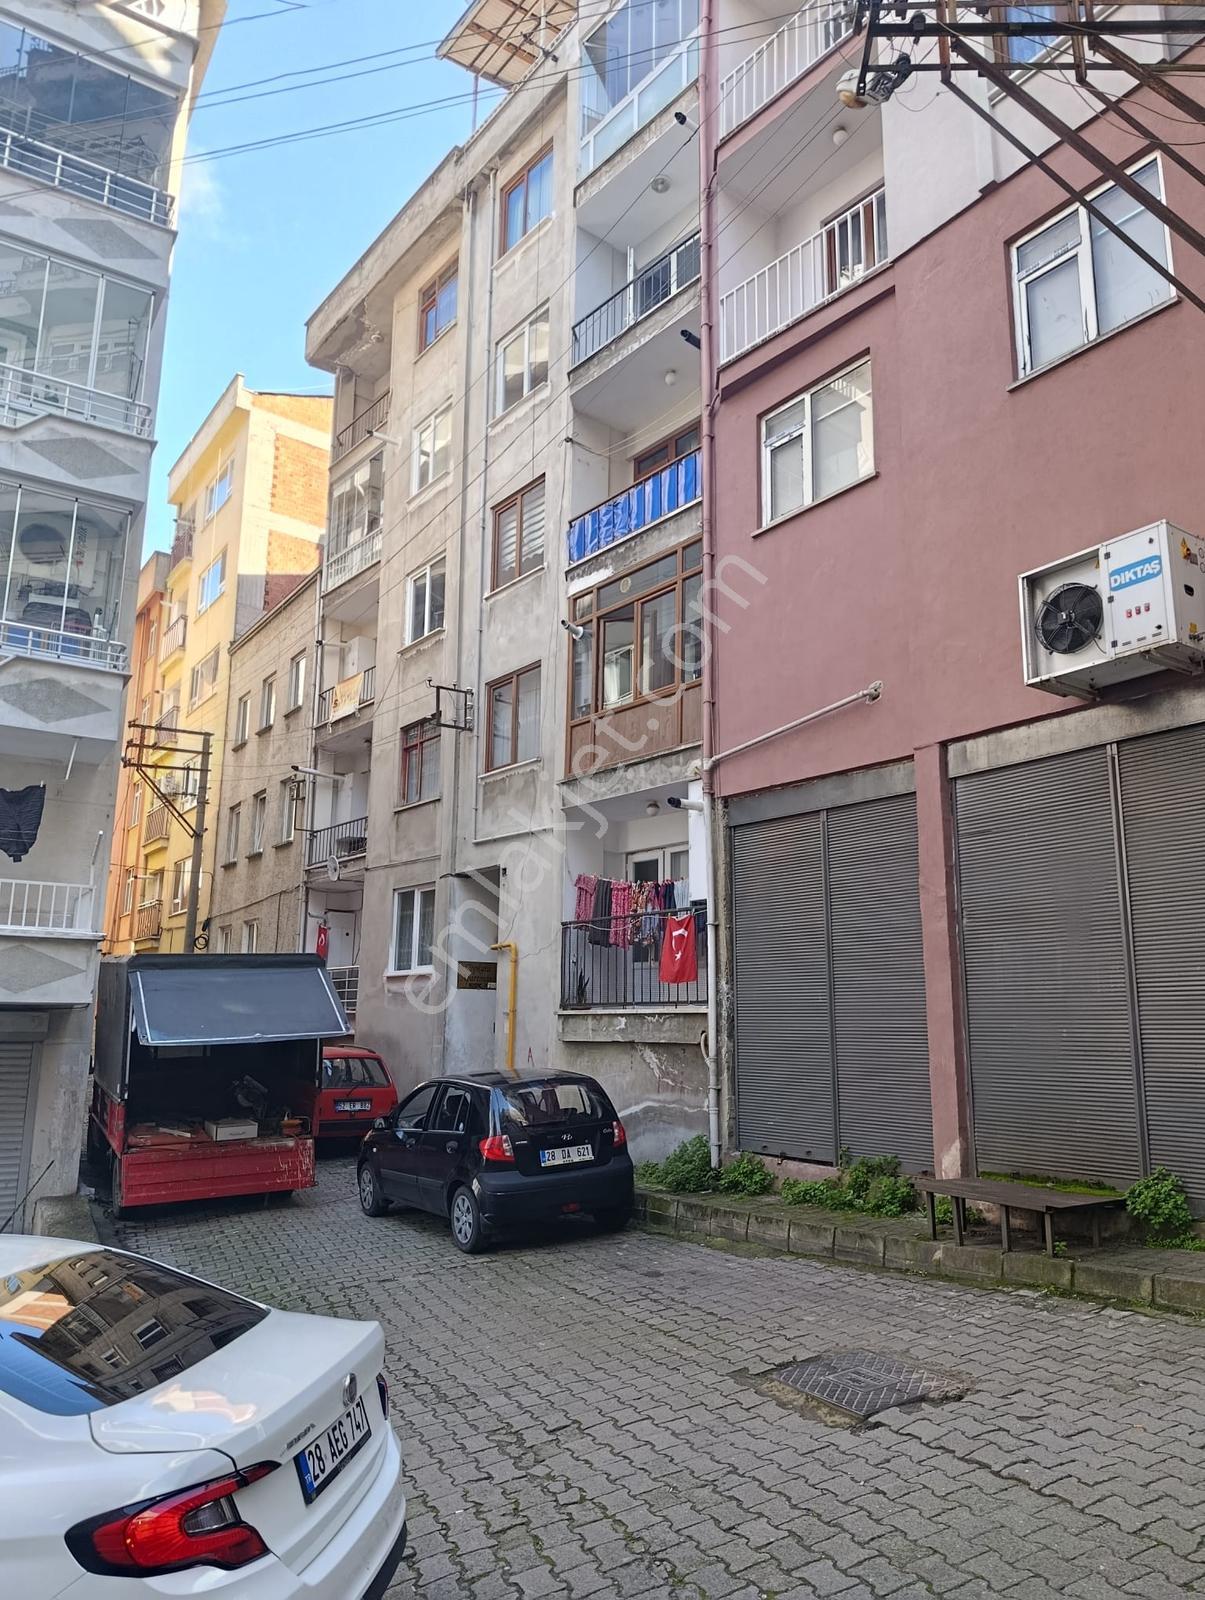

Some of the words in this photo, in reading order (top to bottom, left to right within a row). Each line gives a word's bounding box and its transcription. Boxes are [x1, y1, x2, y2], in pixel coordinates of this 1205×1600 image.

[1110, 560, 1161, 588] DIKTAŞ
[546, 1151, 556, 1161] 28
[561, 1149, 571, 1160] DA
[576, 1146, 590, 1157] 621
[308, 1443, 326, 1482] 28
[327, 1420, 348, 1463] AEG
[346, 1401, 365, 1440] 747
